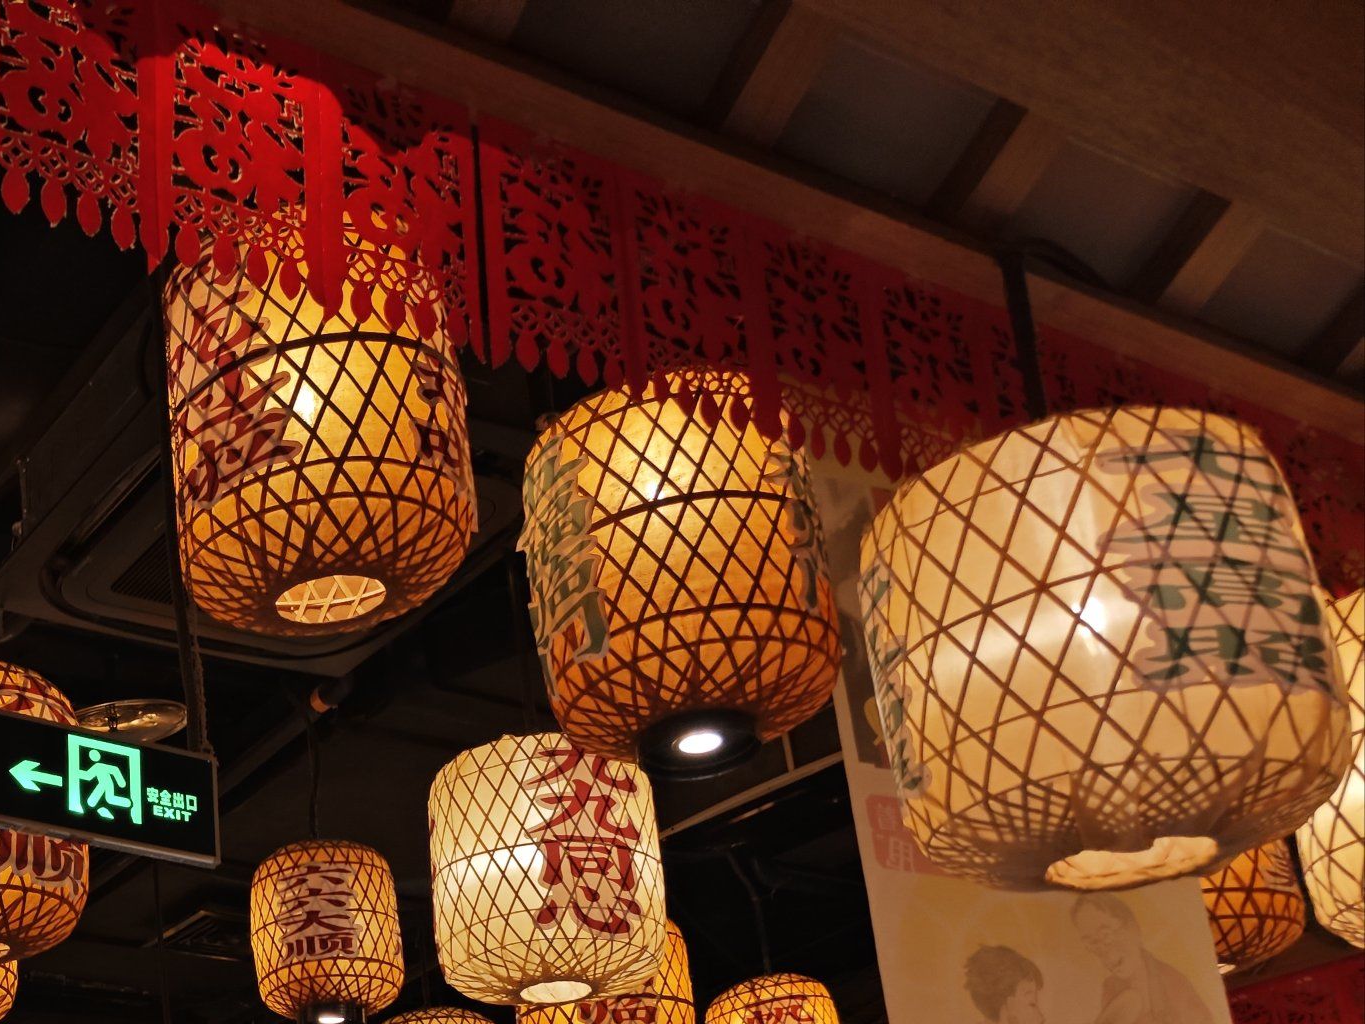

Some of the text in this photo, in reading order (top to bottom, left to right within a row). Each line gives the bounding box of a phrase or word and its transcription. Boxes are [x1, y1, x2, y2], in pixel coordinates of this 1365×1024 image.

[146, 786, 198, 812] 安全出口
[152, 804, 193, 823] EXIT
[279, 865, 359, 961] 六六大顺
